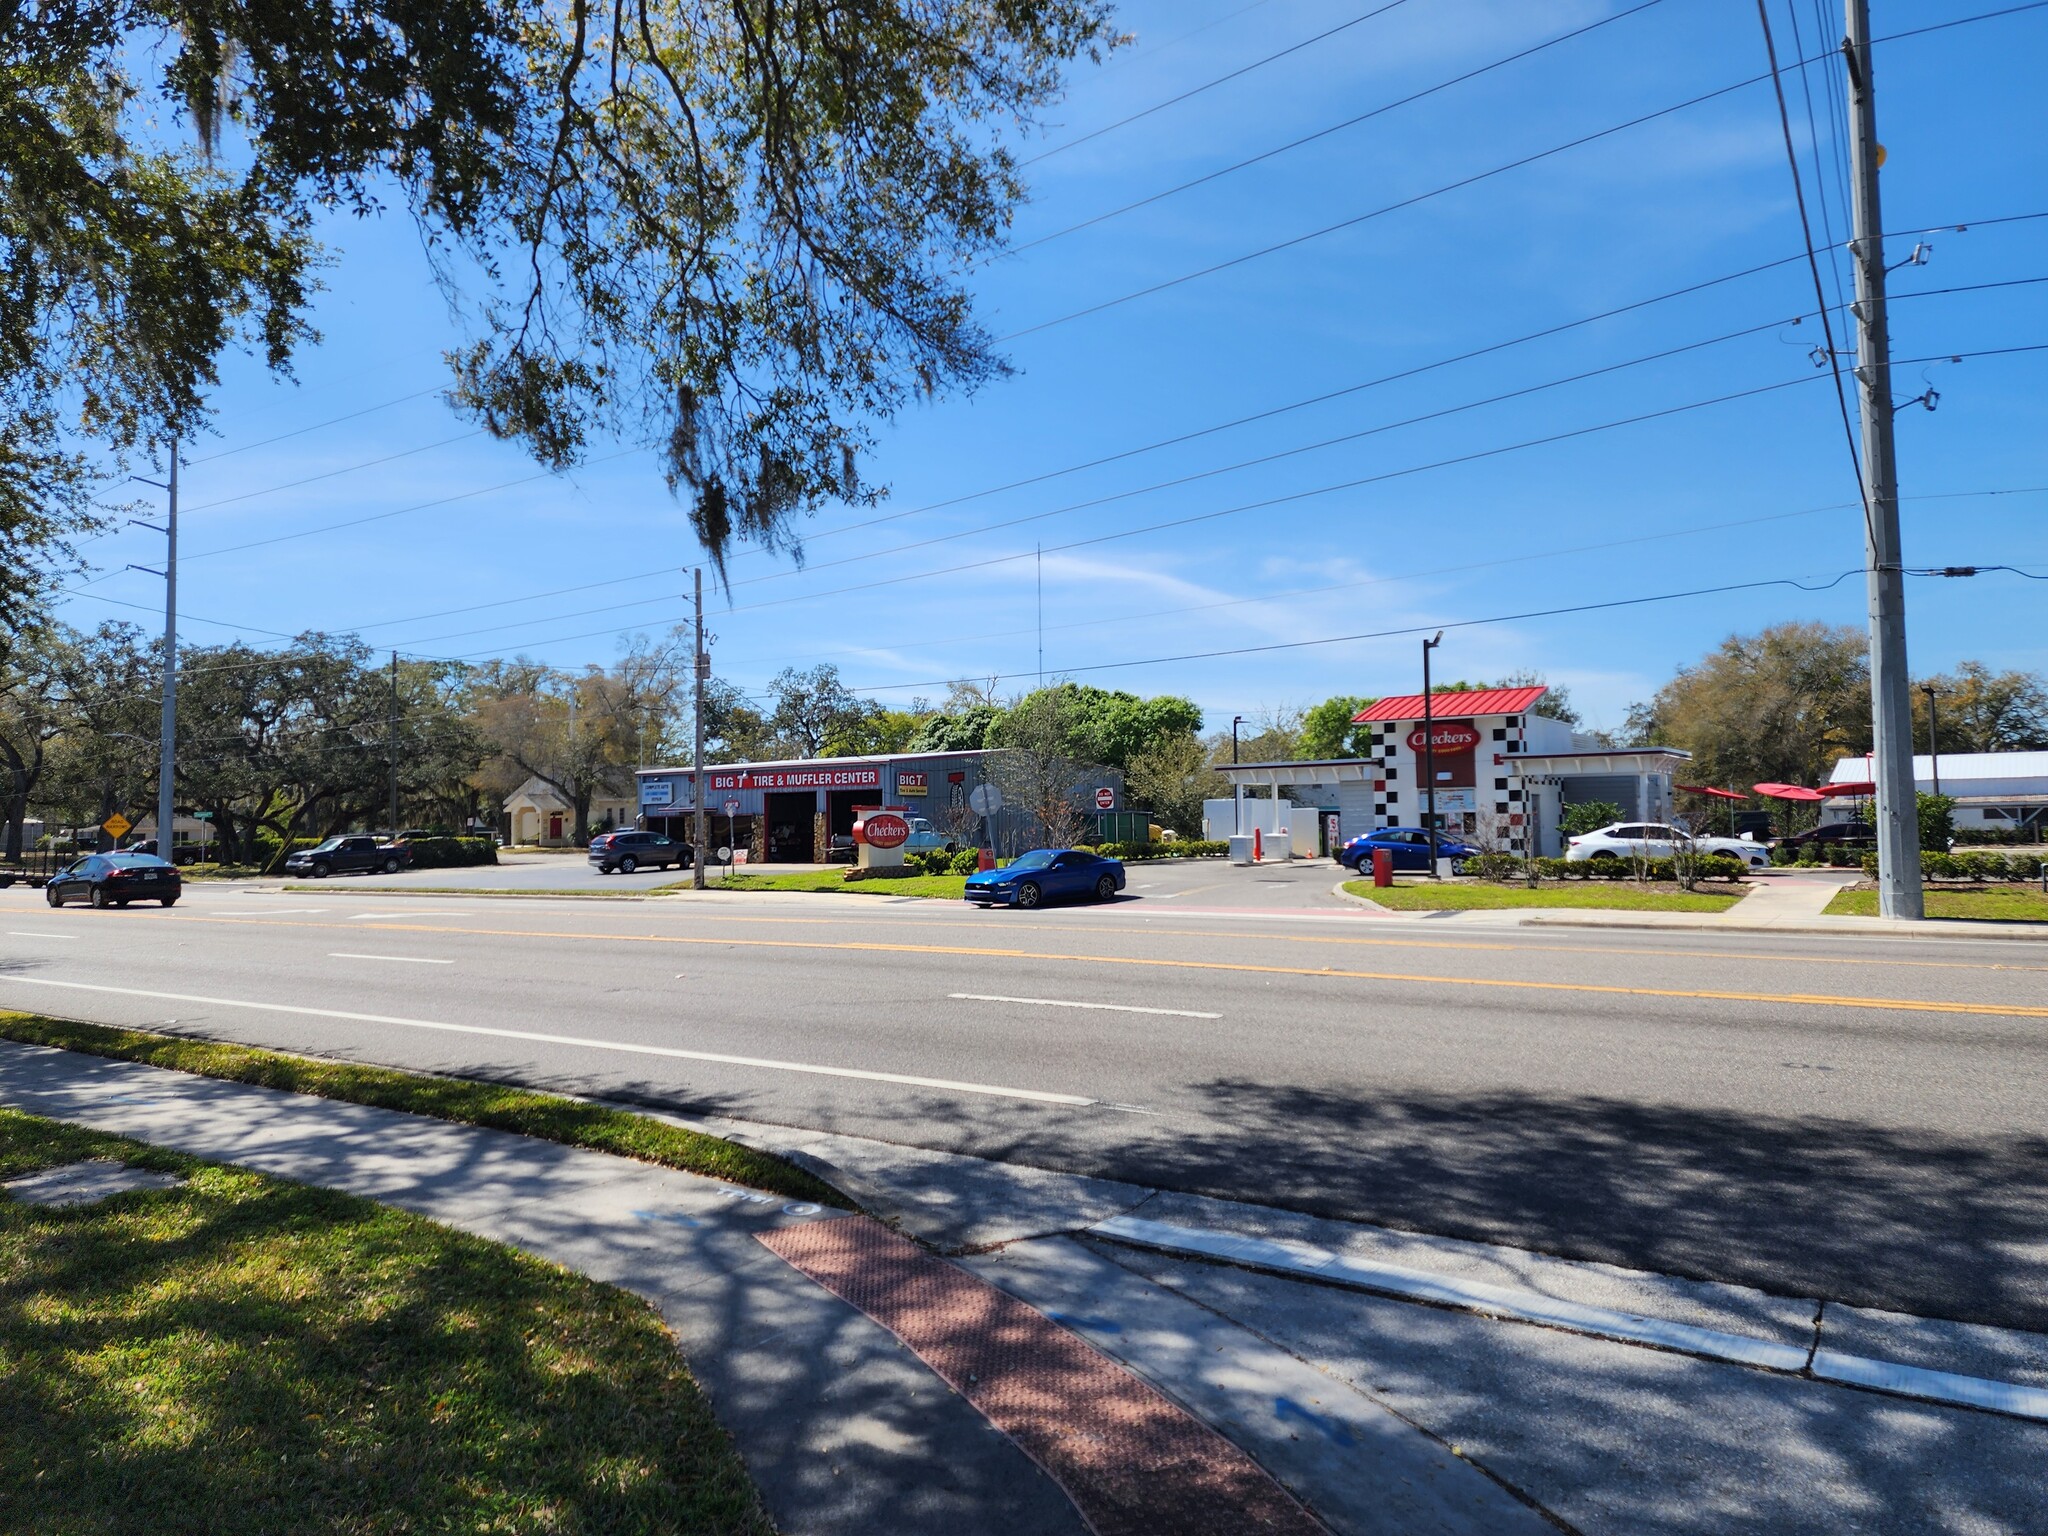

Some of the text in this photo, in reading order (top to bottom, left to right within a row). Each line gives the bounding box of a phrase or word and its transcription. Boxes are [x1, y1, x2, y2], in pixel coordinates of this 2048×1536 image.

[715, 771, 875, 788] BIG T TIRE & MUFFLER CENTER
[900, 774, 923, 786] BIG T
[867, 823, 906, 837] Checkers
